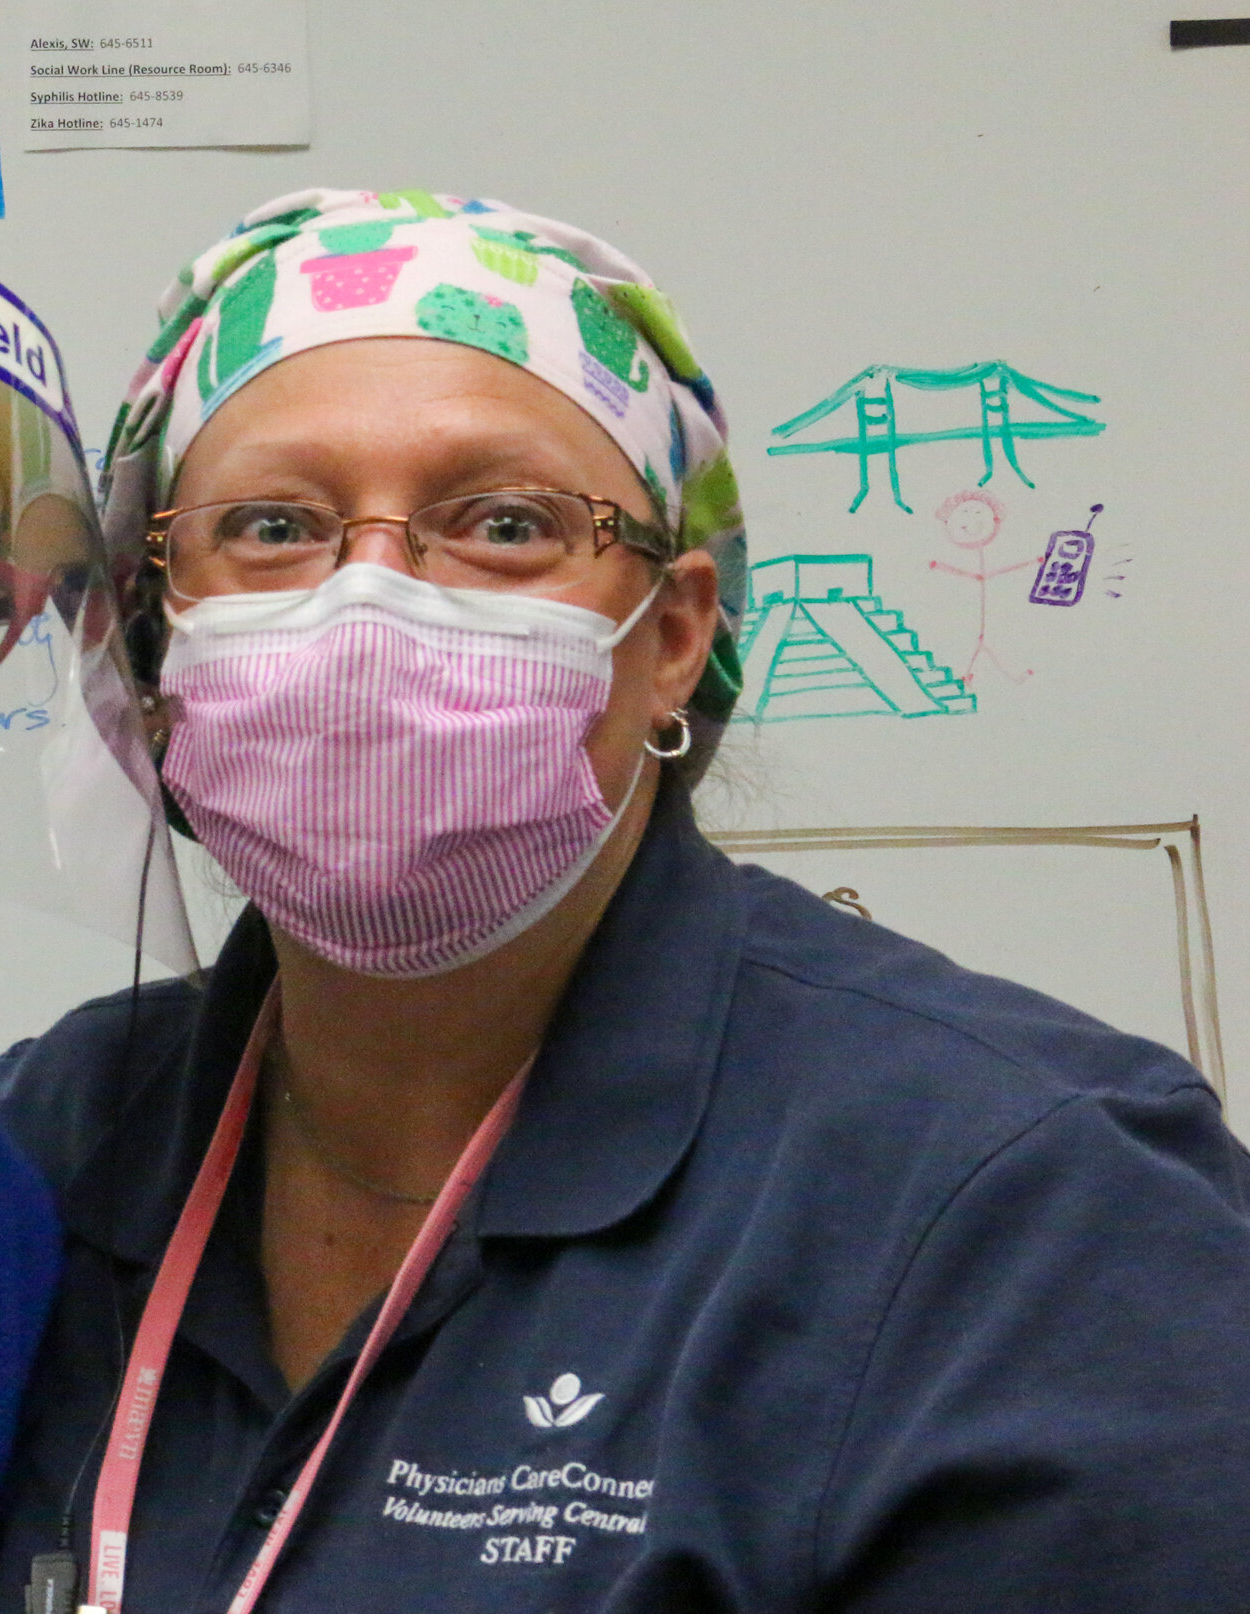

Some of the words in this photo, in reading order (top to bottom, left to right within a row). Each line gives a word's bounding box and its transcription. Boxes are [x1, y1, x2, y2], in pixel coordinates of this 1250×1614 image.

[30, 38, 68, 50] Alexis,
[71, 38, 94, 50] SW:
[100, 37, 153, 49] 645-6511
[30, 64, 64, 76] Social
[67, 64, 99, 75] Work
[102, 64, 125, 75] Line
[128, 64, 186, 77] (Resource
[189, 63, 232, 76] Room):
[237, 63, 292, 74] 645-6346
[30, 91, 75, 104] Syphilis
[77, 91, 124, 103] Hotline:
[129, 90, 184, 102] 645-8539
[30, 118, 55, 129] Zika
[58, 118, 103, 129] Hotline:
[109, 117, 163, 129] 645-1474
[386, 1459, 506, 1496] Physicians
[382, 1496, 486, 1529] Volunteers
[486, 1502, 559, 1529] Serving
[564, 1501, 648, 1534] Central
[480, 1535, 577, 1565] STAFF
